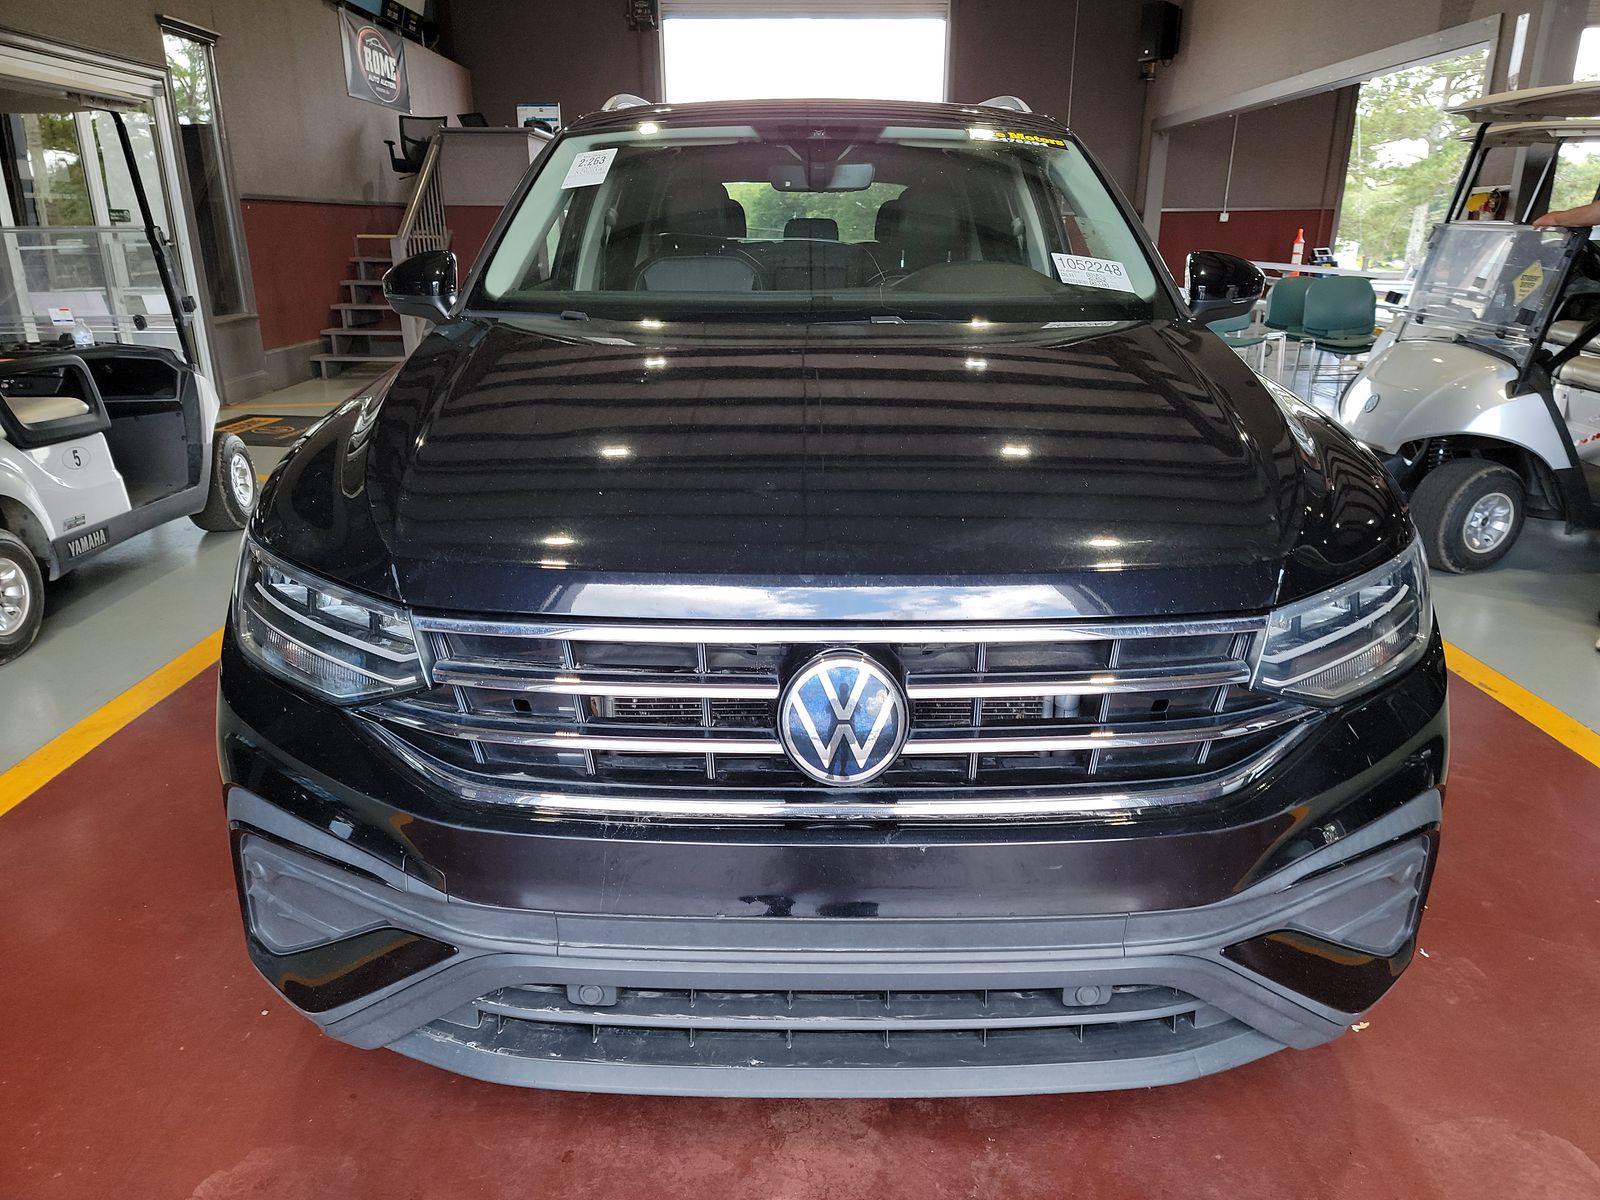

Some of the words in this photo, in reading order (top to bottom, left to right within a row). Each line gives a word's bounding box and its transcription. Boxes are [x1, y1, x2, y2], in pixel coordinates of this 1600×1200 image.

[364, 45, 397, 81] ROME
[368, 74, 380, 83] AUTO
[1007, 131, 1065, 146] Motors
[1058, 257, 1122, 276] 1052248
[72, 449, 82, 467] 5
[68, 529, 106, 557] YAMAHA
